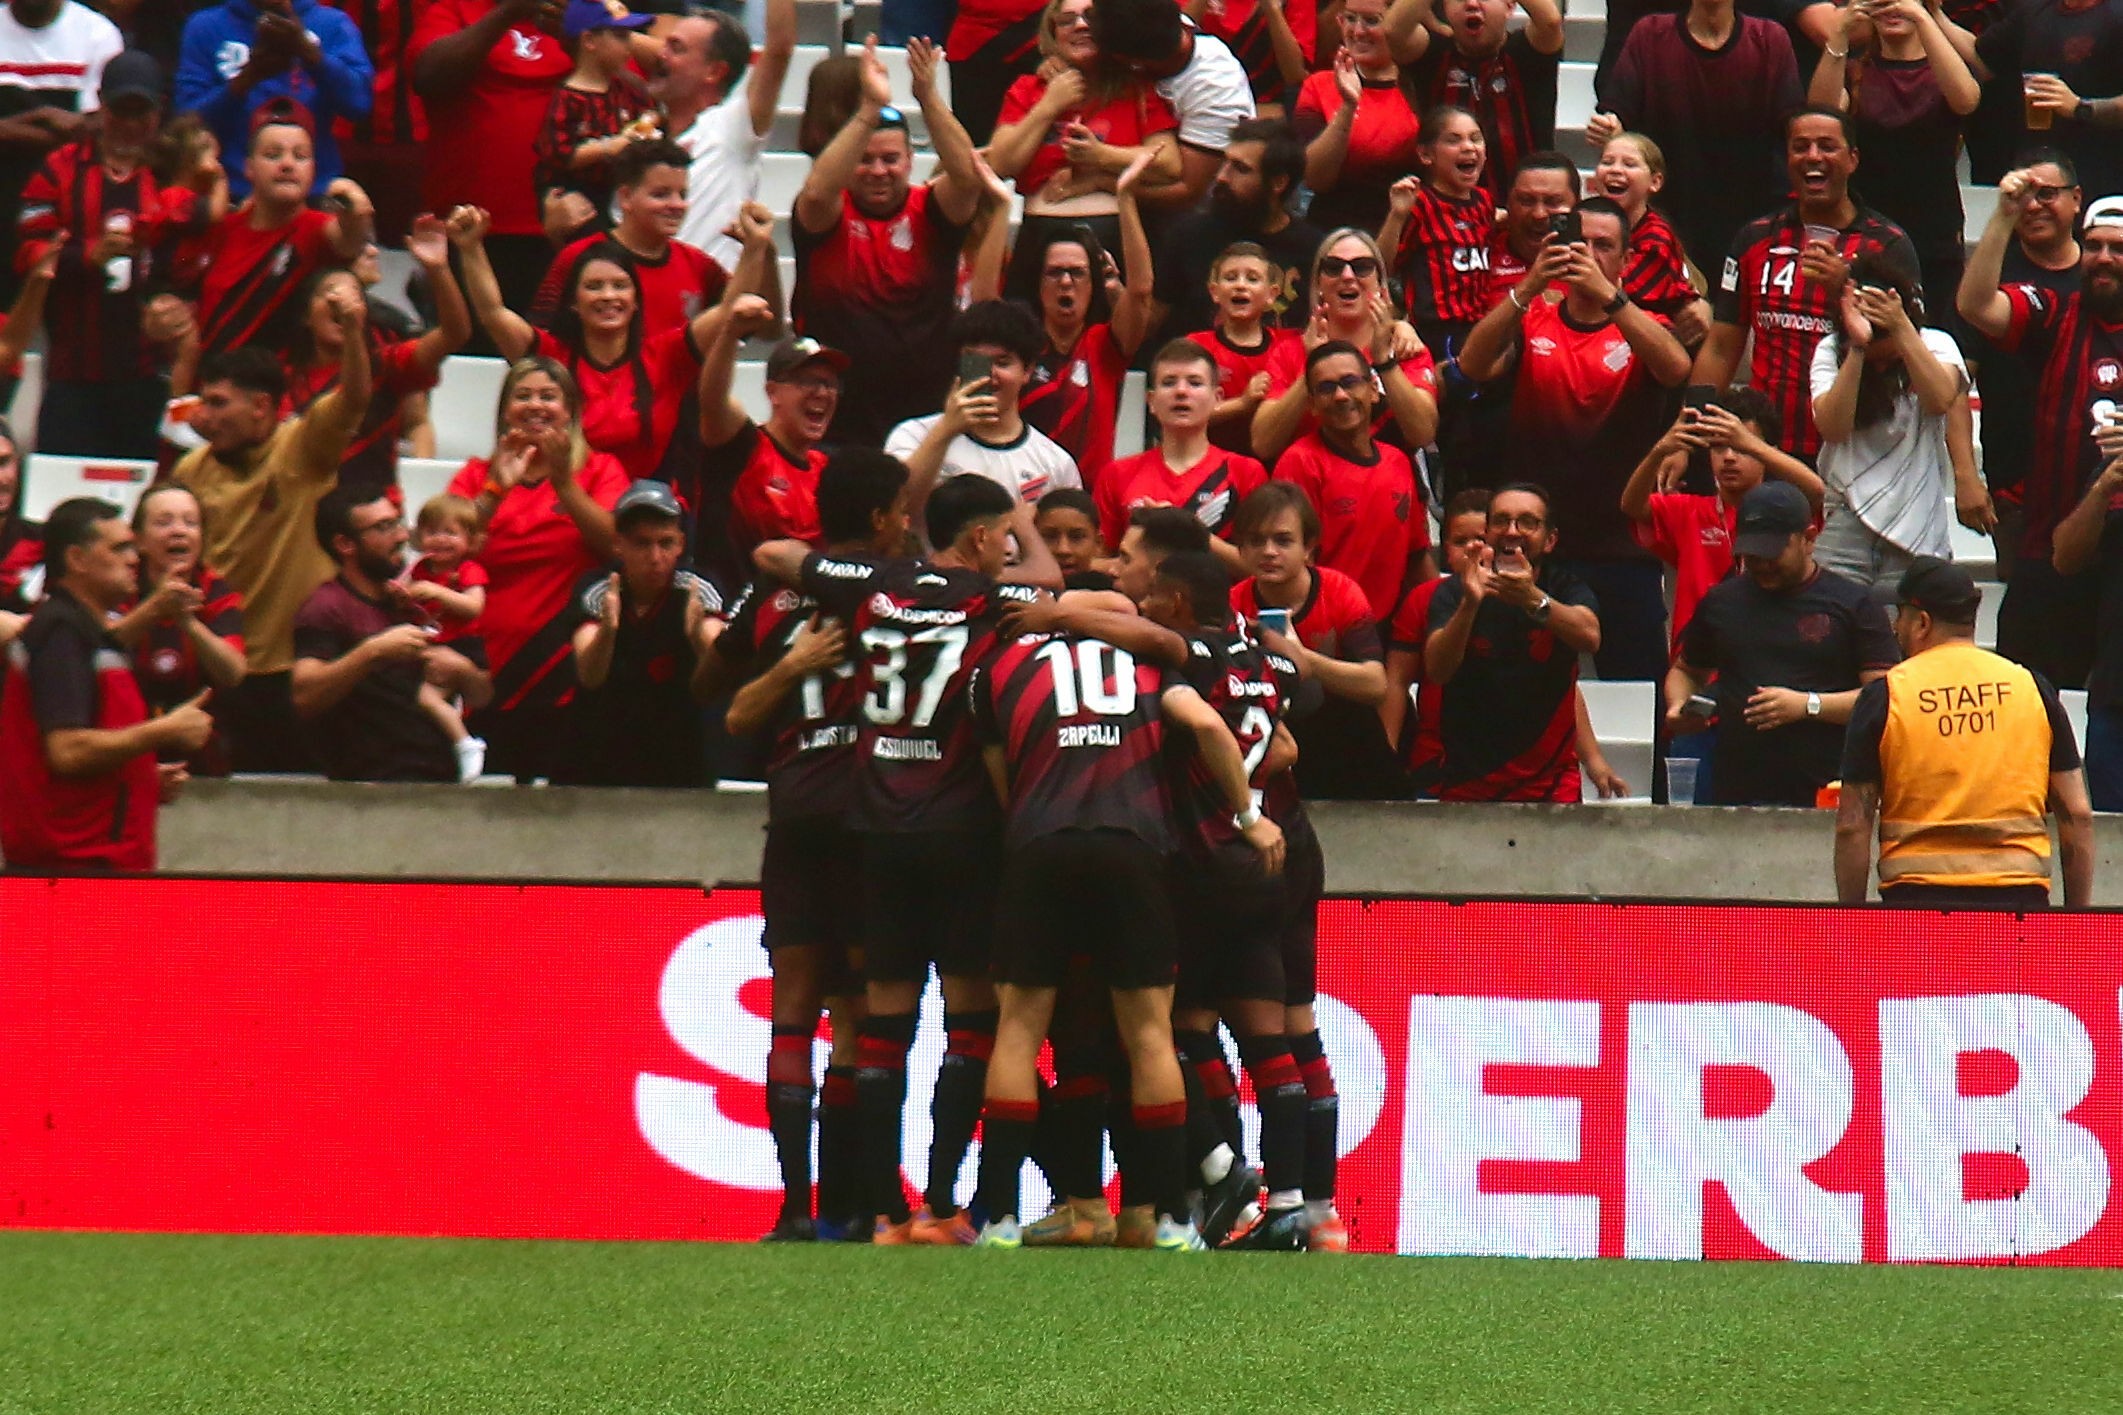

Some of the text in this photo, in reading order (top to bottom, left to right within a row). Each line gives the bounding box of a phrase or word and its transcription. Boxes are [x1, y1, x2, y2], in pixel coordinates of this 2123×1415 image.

[1760, 260, 1797, 295] 14
[816, 558, 875, 580] HAVAN
[998, 585, 1055, 603] HAV
[860, 625, 970, 728] 37
[1034, 638, 1137, 718] 10
[1918, 682, 2012, 714] STAFF
[1058, 726, 1121, 748] ZAPELLI
[1938, 709, 1995, 737] 0701
